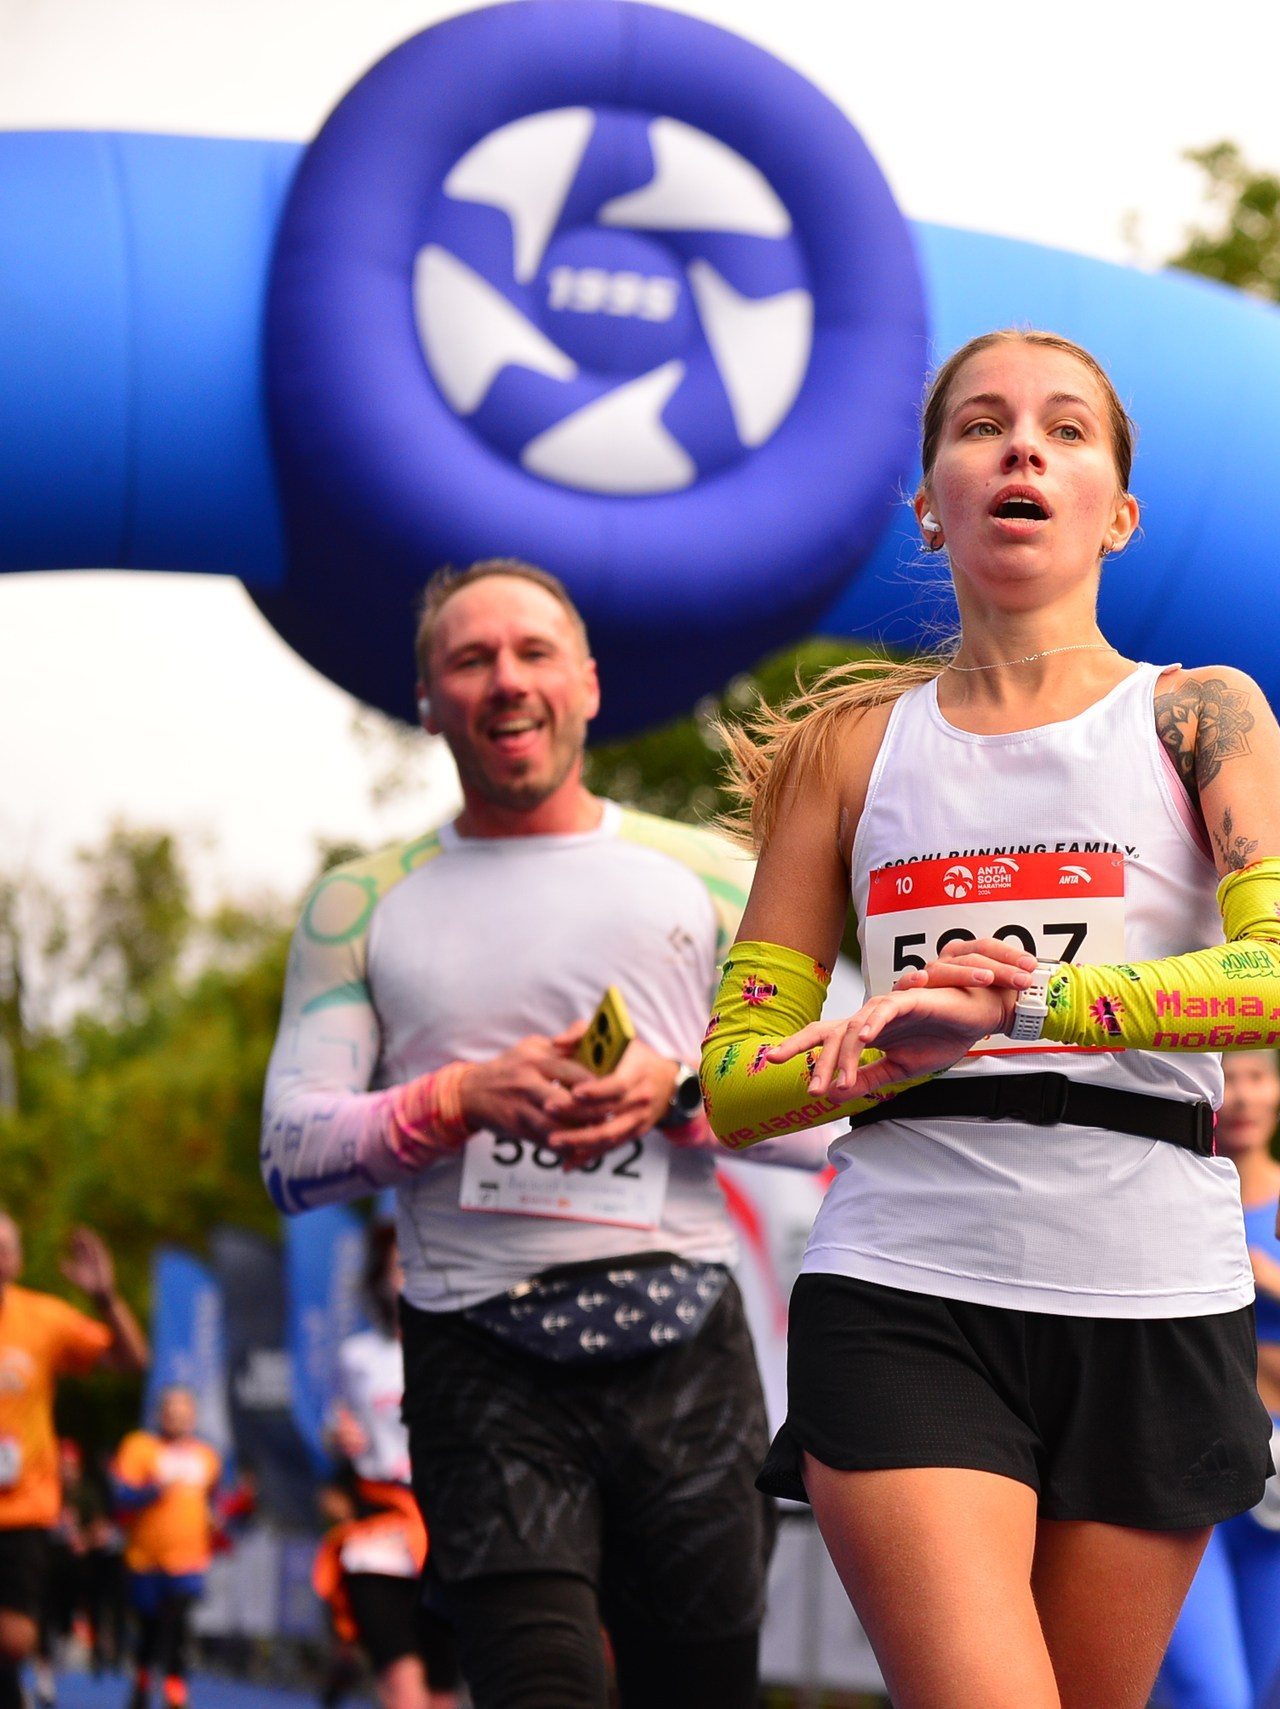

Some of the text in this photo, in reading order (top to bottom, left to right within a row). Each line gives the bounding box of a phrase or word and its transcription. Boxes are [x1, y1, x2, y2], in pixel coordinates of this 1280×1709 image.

[977, 866, 1007, 875] ANTA
[895, 876, 913, 895] 10
[977, 874, 1012, 884] SOCHI
[1059, 875, 1079, 884] ANTA
[1217, 950, 1276, 970] WONDER
[1156, 990, 1280, 1020] Мама,
